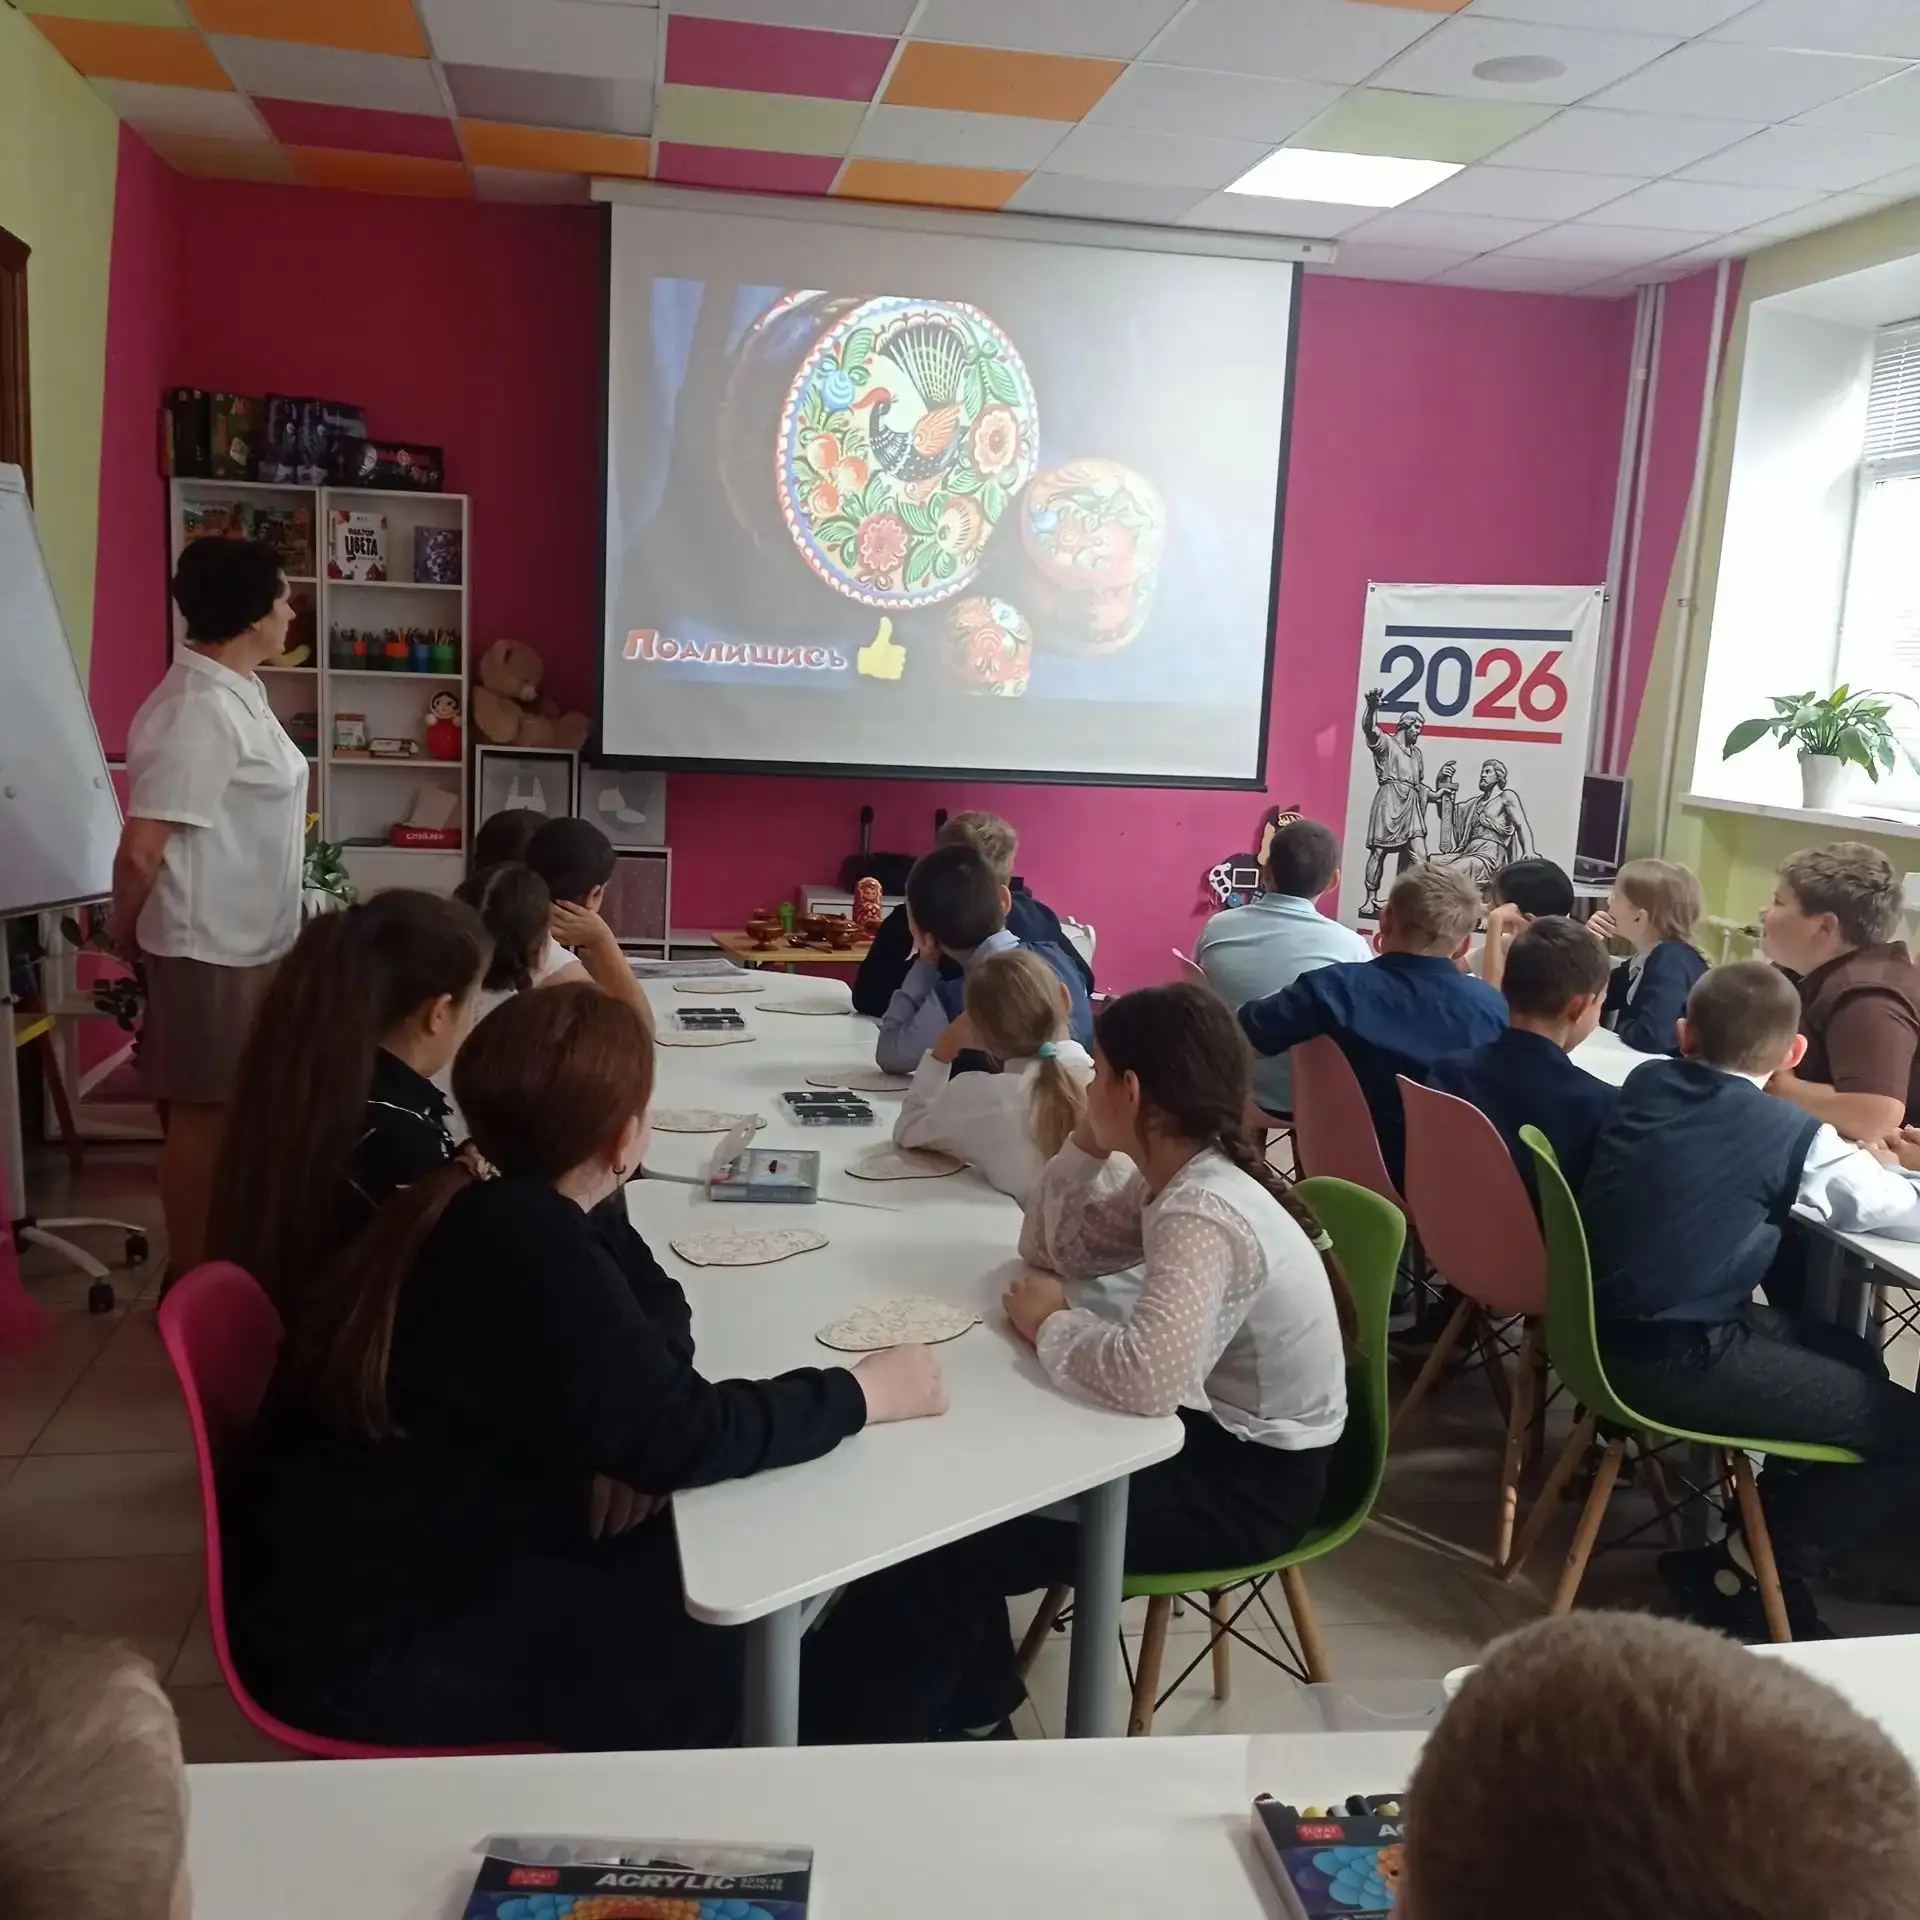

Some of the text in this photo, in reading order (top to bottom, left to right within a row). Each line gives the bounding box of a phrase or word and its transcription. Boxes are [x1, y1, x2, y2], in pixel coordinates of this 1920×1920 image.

[345, 535, 378, 562] ЦВЕТА
[623, 628, 848, 670] Подпишись
[1378, 644, 1568, 723] 2026
[594, 1873, 736, 1889] ACRYLIC
